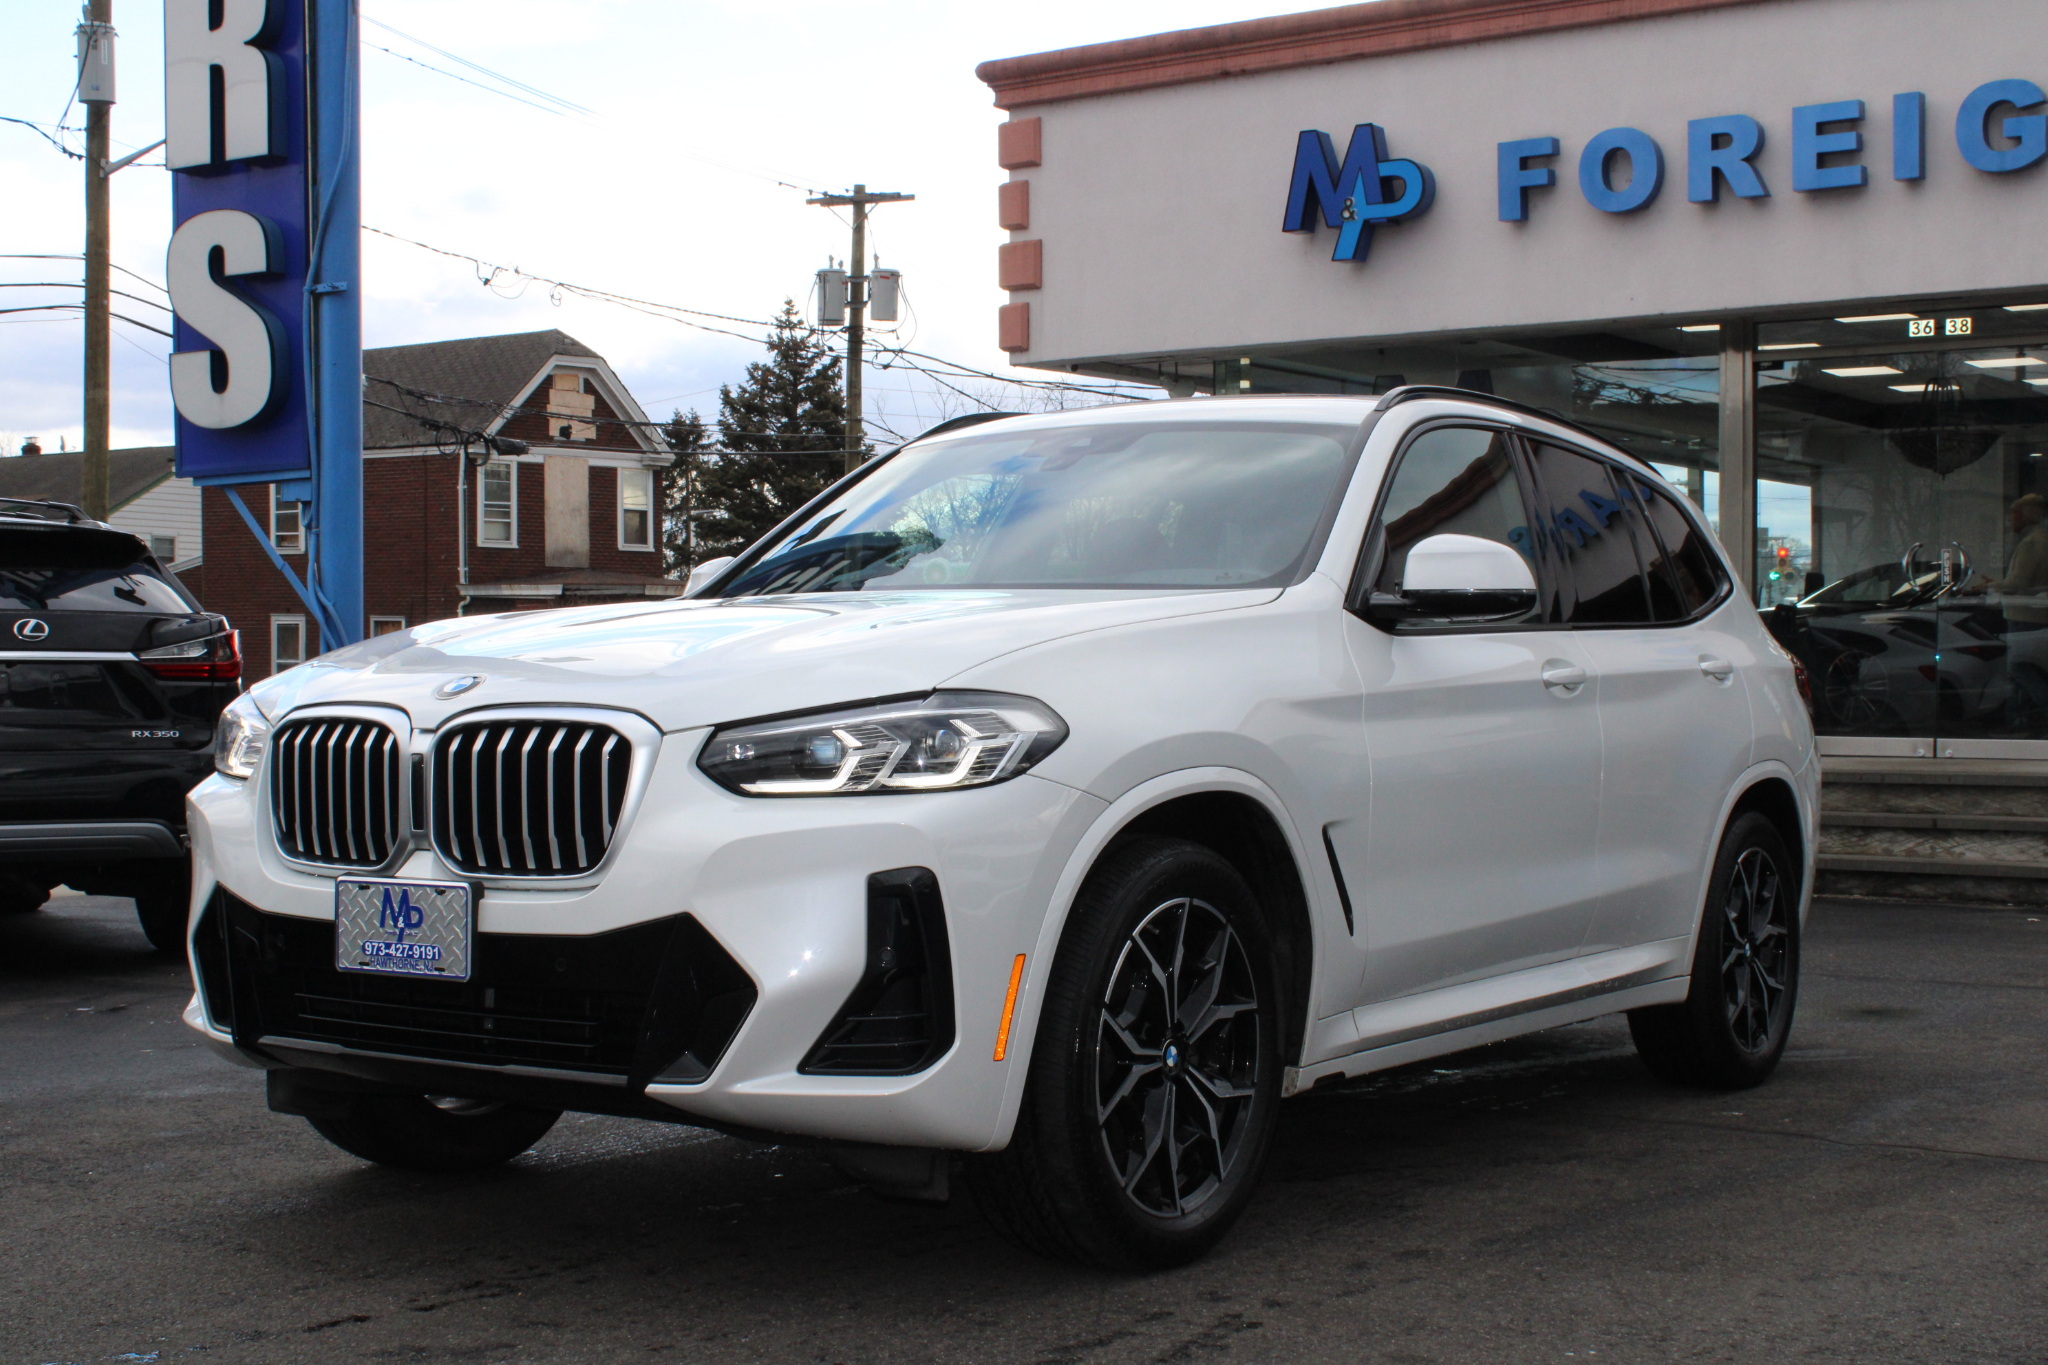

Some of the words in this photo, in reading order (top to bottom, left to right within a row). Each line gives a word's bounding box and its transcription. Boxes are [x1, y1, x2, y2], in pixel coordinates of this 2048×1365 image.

[1497, 77, 2048, 223] FOREIG
[1910, 320, 1934, 336] 36
[1947, 318, 1970, 335] 38
[1942, 551, 1951, 584] PUSH
[364, 942, 439, 960] 973-427-9191
